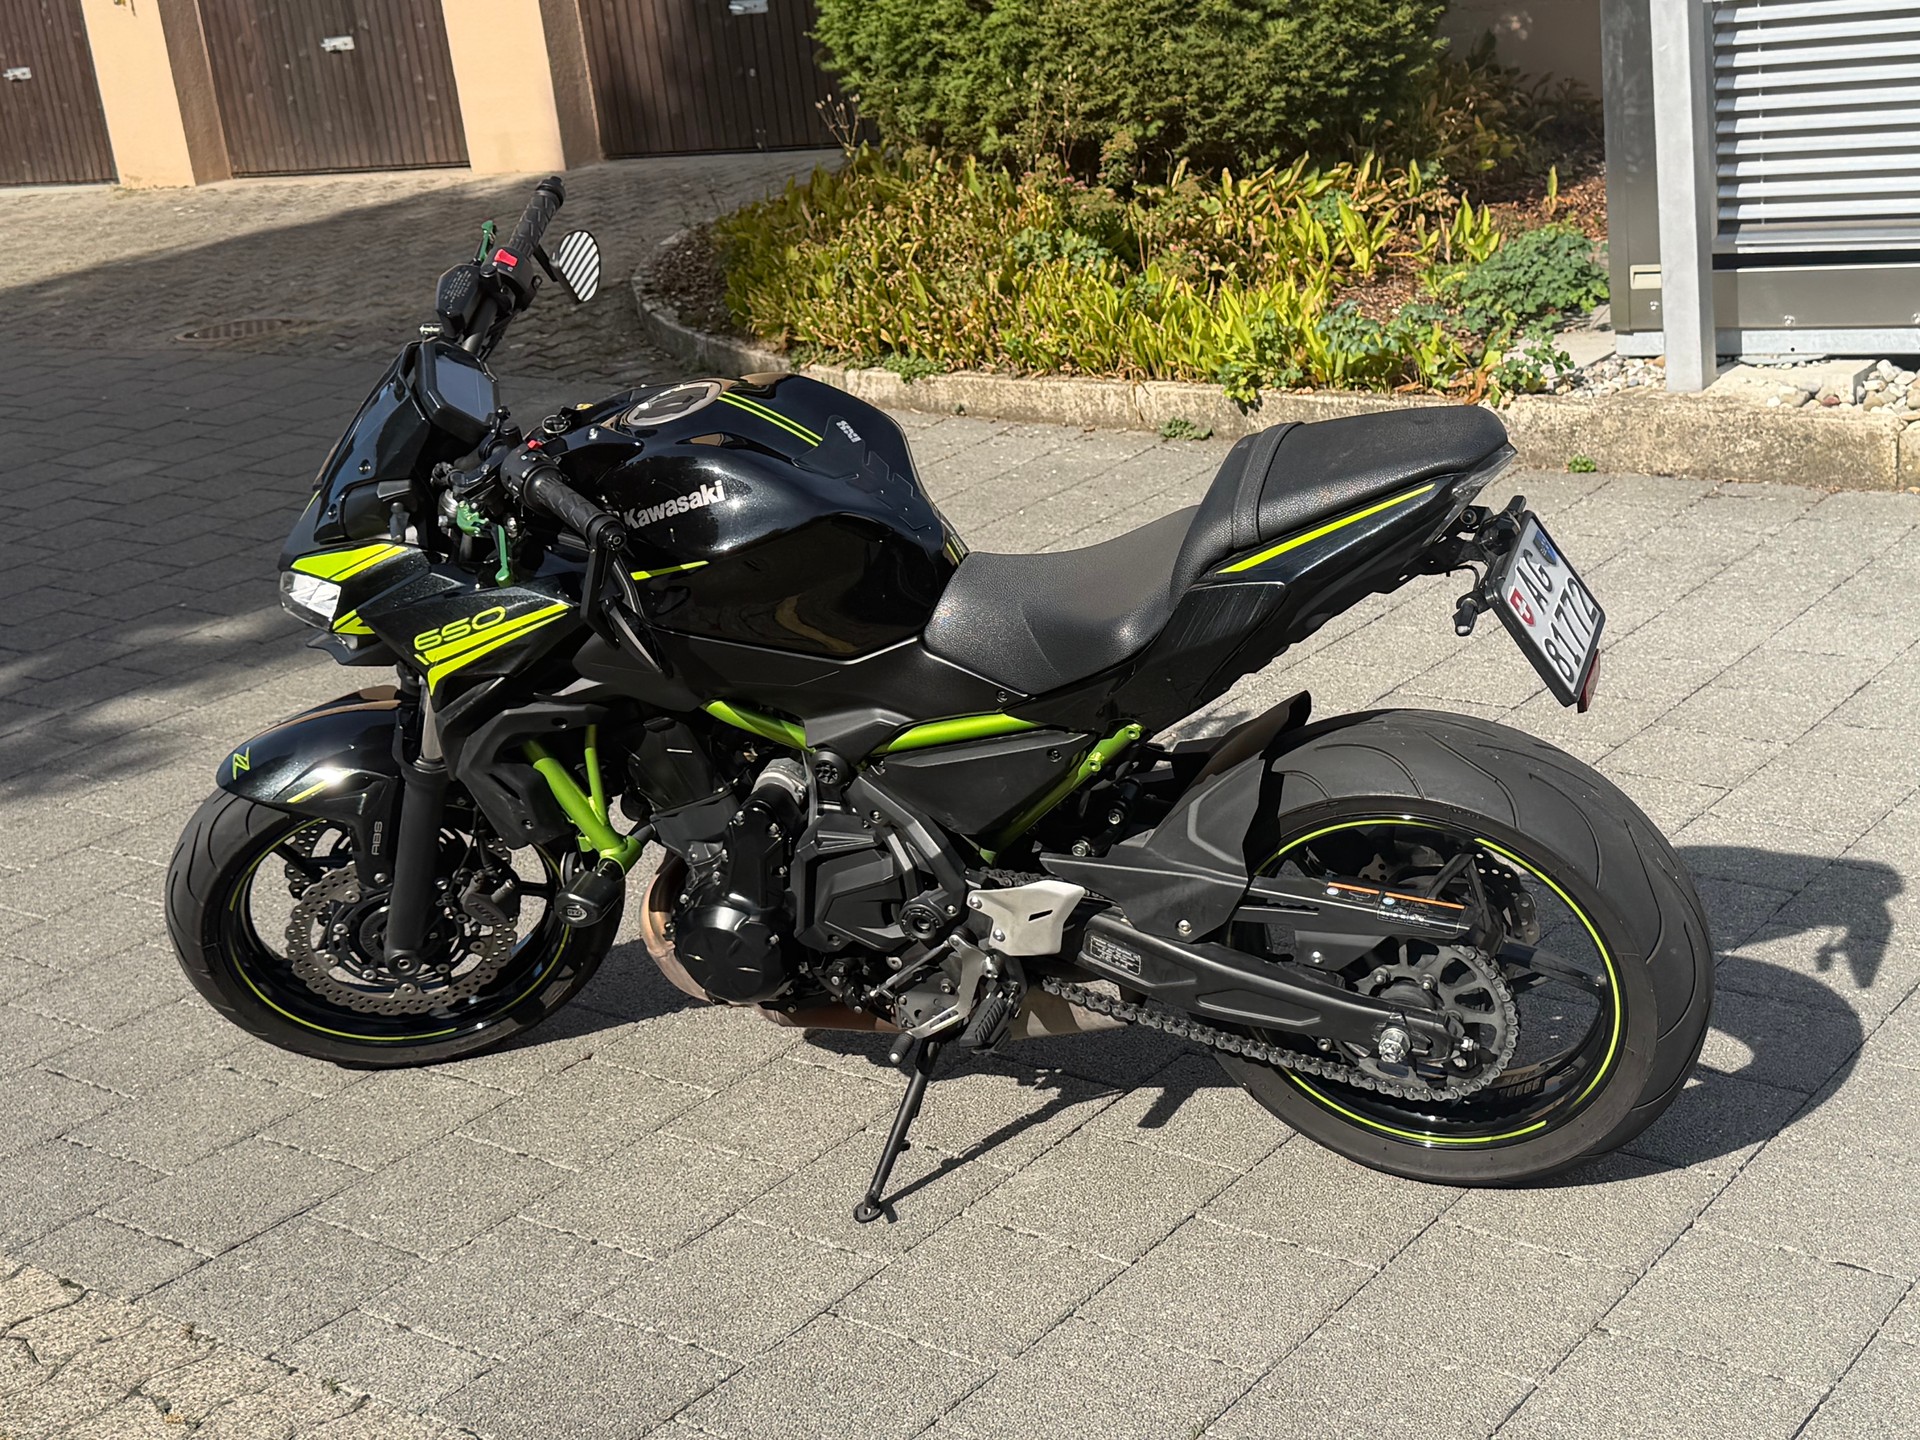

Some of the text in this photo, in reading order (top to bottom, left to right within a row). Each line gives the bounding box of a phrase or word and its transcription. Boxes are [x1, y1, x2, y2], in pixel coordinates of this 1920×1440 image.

[623, 480, 726, 529] Kawasaki
[1516, 549, 1553, 615] AG
[413, 606, 506, 651] 650
[1544, 577, 1598, 683] 81772
[371, 821, 383, 856] ABS
